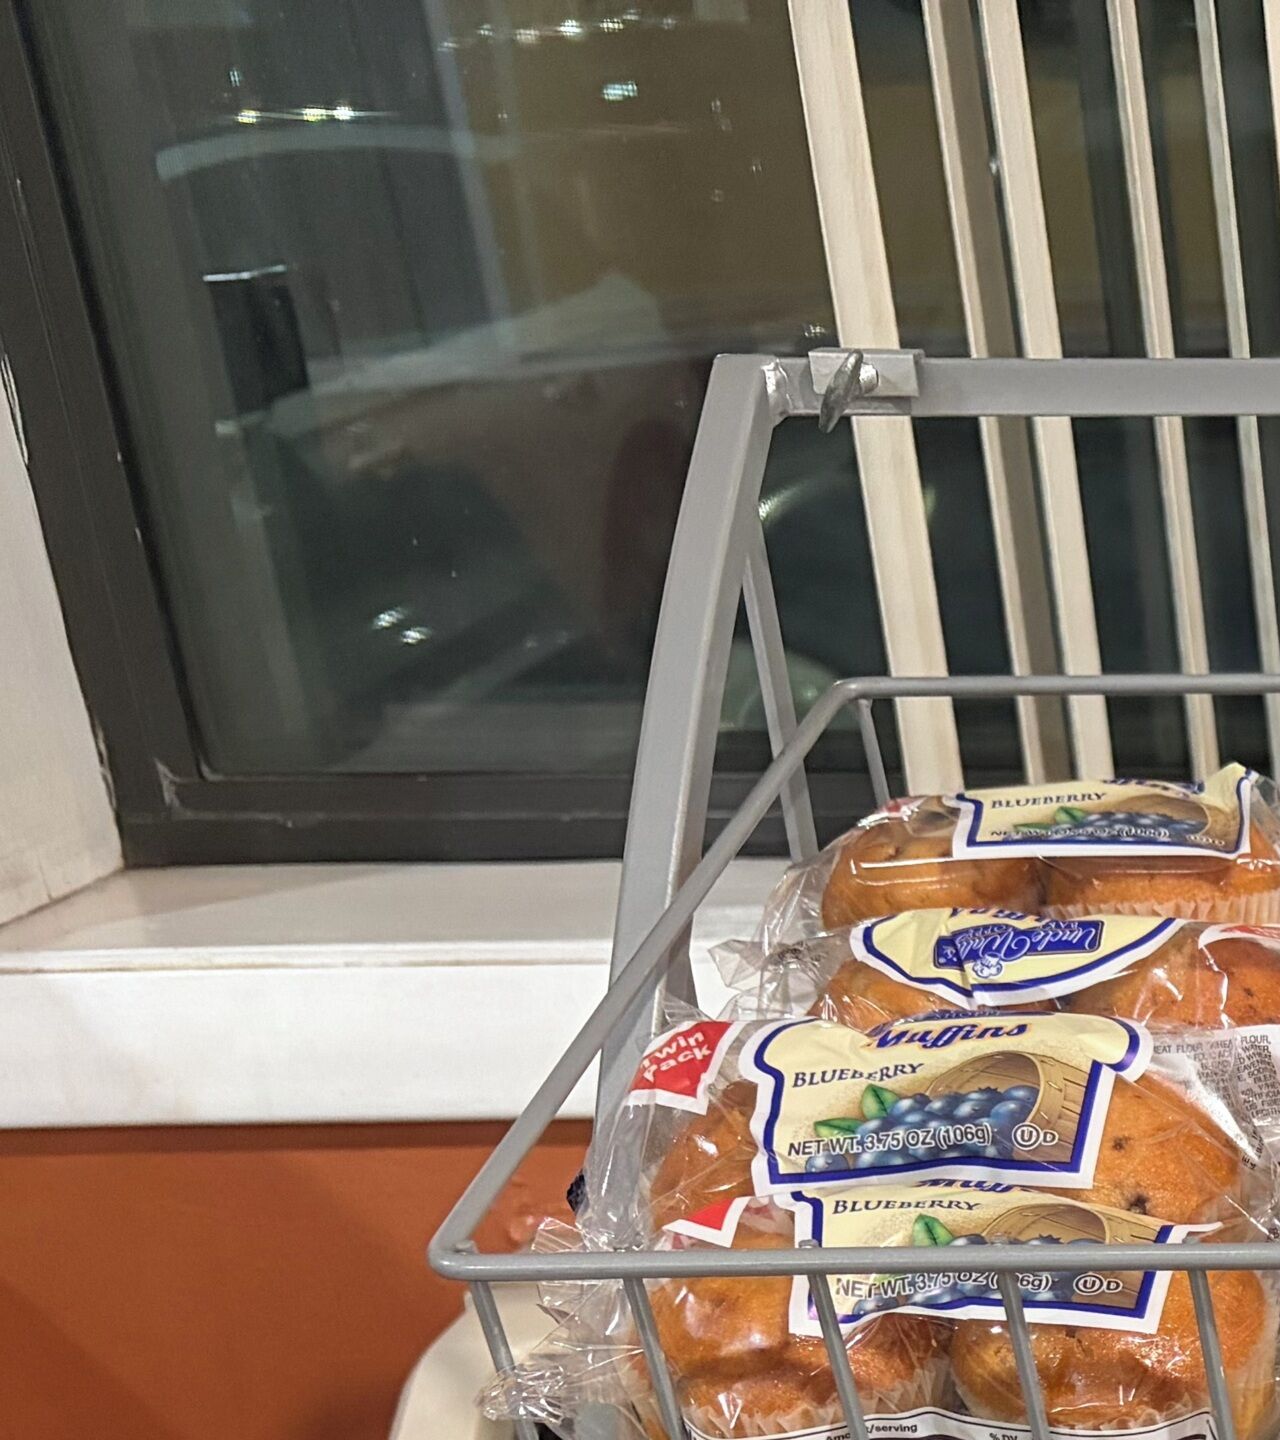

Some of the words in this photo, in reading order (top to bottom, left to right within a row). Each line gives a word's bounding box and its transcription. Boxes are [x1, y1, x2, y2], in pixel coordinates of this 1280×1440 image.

[991, 792, 1107, 809] BLUEBERRY
[1032, 926, 1096, 951] Uncle
[641, 1031, 705, 1069] Twin
[866, 1022, 1030, 1050] Muffins
[643, 1043, 712, 1083] Pack
[792, 1061, 925, 1089] BLUEBERRY
[788, 1136, 826, 1157] NET
[830, 1132, 863, 1155] WT.
[864, 1129, 901, 1151] 3.75
[906, 1127, 937, 1148] OZ
[937, 1122, 993, 1148] (106g)
[832, 1199, 981, 1215] BLUEBERRY
[836, 1276, 875, 1298] NET
[881, 1275, 912, 1296] WT.
[916, 1273, 952, 1293] 3.75
